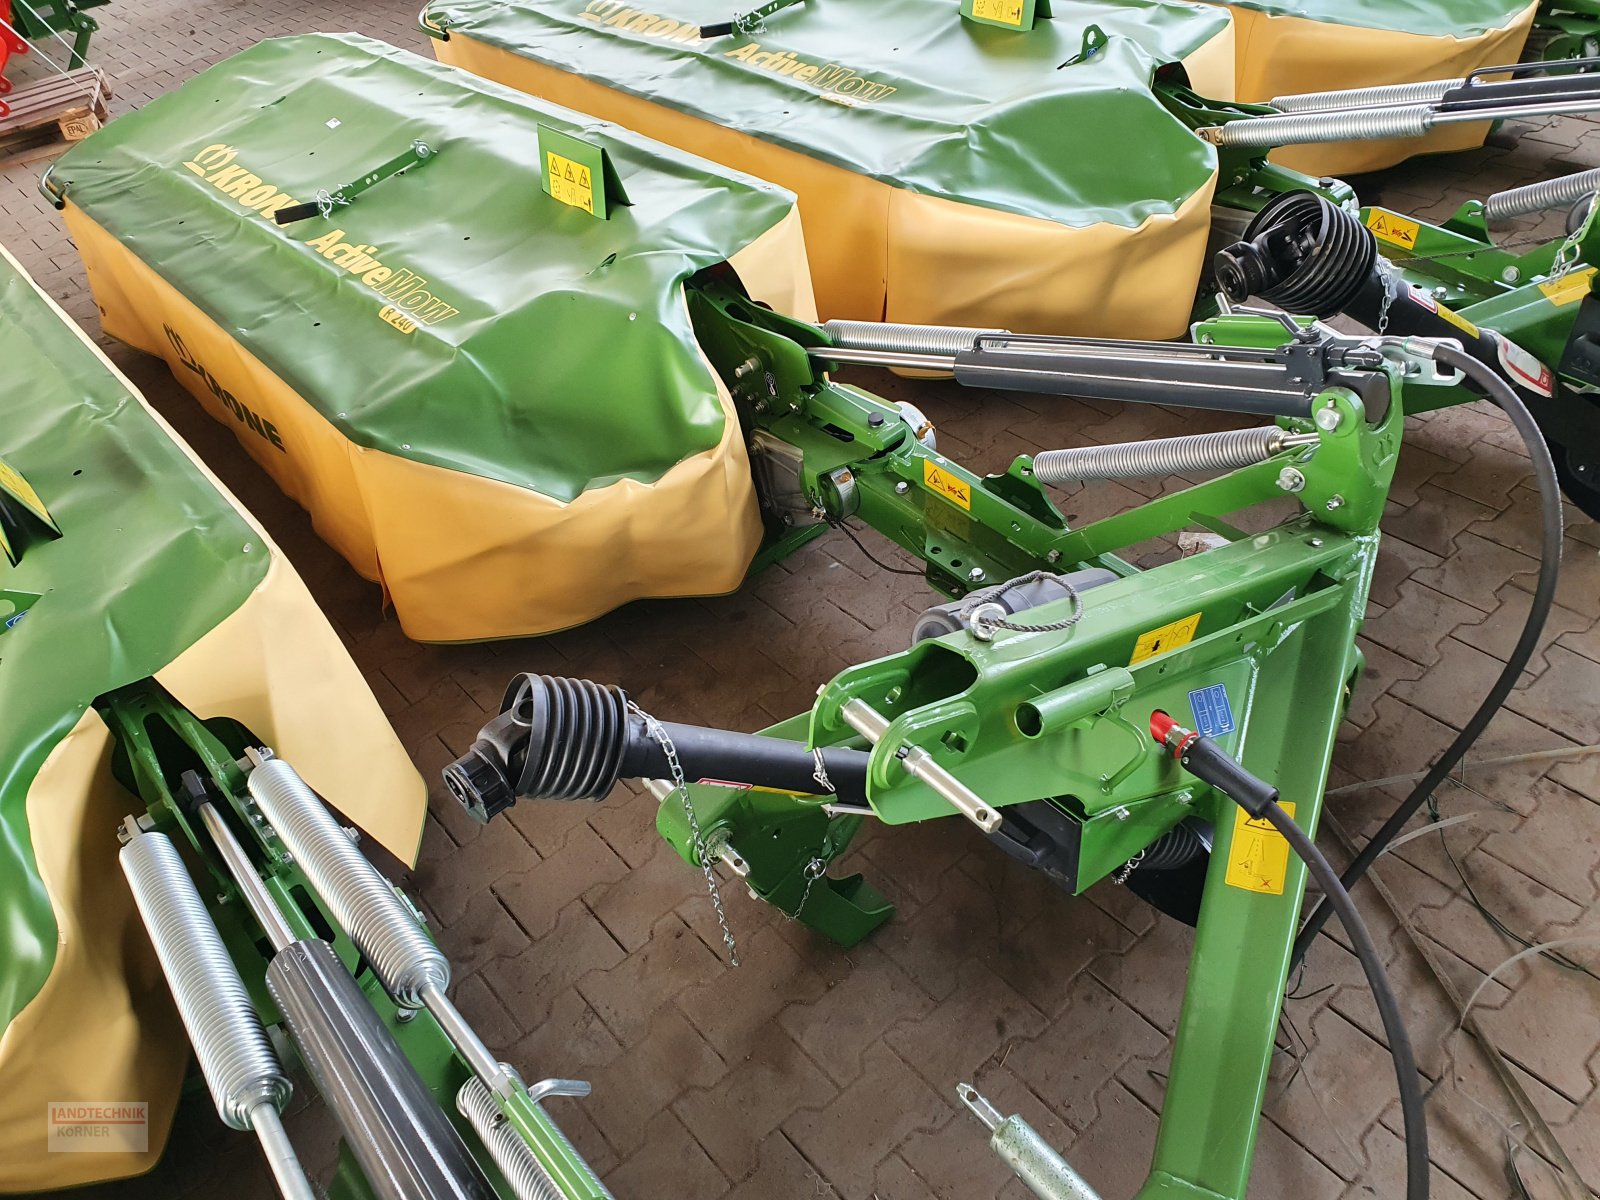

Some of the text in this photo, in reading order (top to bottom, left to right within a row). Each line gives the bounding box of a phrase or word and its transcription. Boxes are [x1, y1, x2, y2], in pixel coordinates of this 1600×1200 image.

[724, 42, 898, 103] ActiveMow
[67, 124, 85, 135] EPAL
[205, 164, 301, 229] KRON
[304, 229, 460, 326] ActiveMow
[383, 308, 414, 331] R 240
